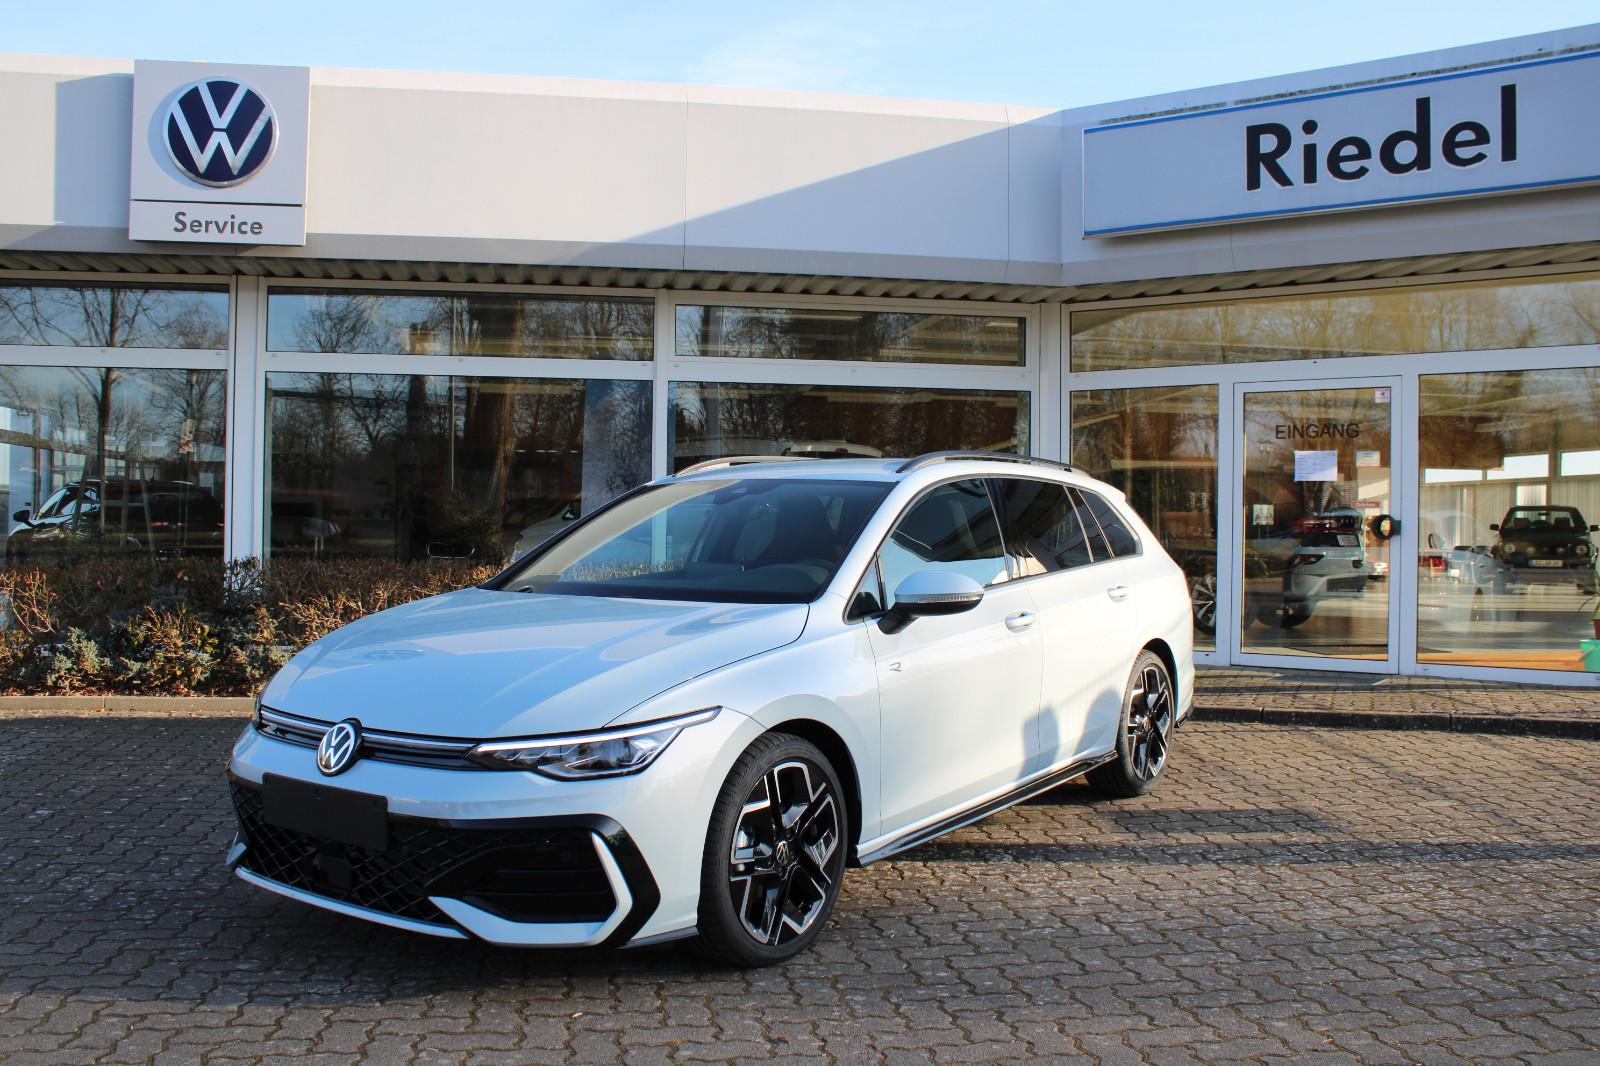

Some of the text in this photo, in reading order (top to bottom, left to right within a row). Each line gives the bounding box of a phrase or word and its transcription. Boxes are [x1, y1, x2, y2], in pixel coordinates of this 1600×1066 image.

[1246, 84, 1517, 191] Riedel
[173, 211, 263, 235] Service
[1275, 423, 1360, 440] EINGANG
